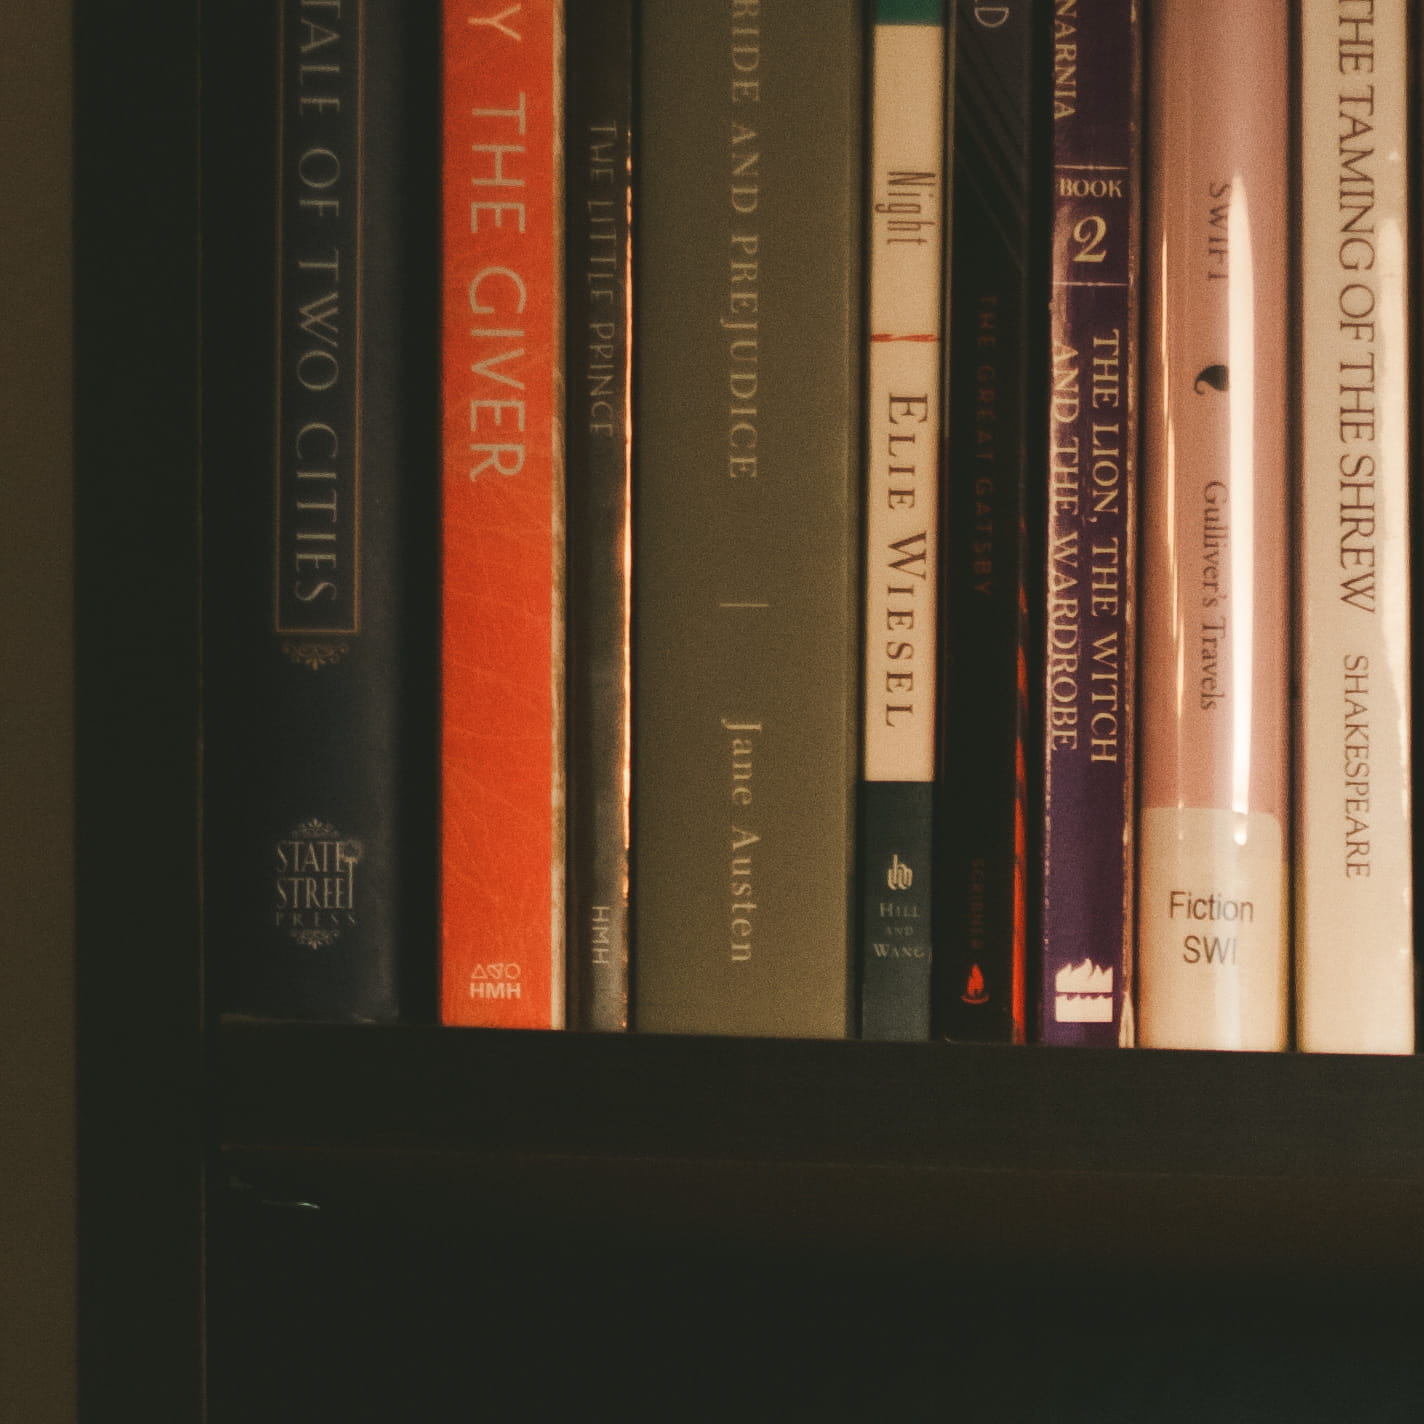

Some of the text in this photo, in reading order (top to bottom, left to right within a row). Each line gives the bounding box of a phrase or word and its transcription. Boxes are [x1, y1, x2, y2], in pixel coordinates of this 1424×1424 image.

[469, 92, 525, 482] THE GIVER
[588, 120, 617, 438] THE LITTLE PRINCE
[720, 120, 759, 479] AND PREJUDICE
[876, 170, 936, 247] Night
[1058, 177, 1123, 198] BOOK
[1071, 215, 1108, 264] 2
[292, 149, 342, 603] OF TWO CITIES
[973, 296, 996, 596] THE GREAT GATSBY
[1337, 84, 1377, 615] TAMING OF THE SHREW
[884, 391, 928, 728] ELIE WIESEL
[1051, 343, 1080, 751] AND THE WARDROBE
[1086, 329, 1120, 764] THE LION, THE WITCH
[1200, 481, 1229, 710] Gulliver's Travels
[720, 718, 762, 963] Jane Austen
[1343, 654, 1371, 879] SHAKESPEARE
[468, 981, 522, 999] HMH
[592, 905, 611, 964] HMH
[1168, 890, 1255, 923] Fiction
